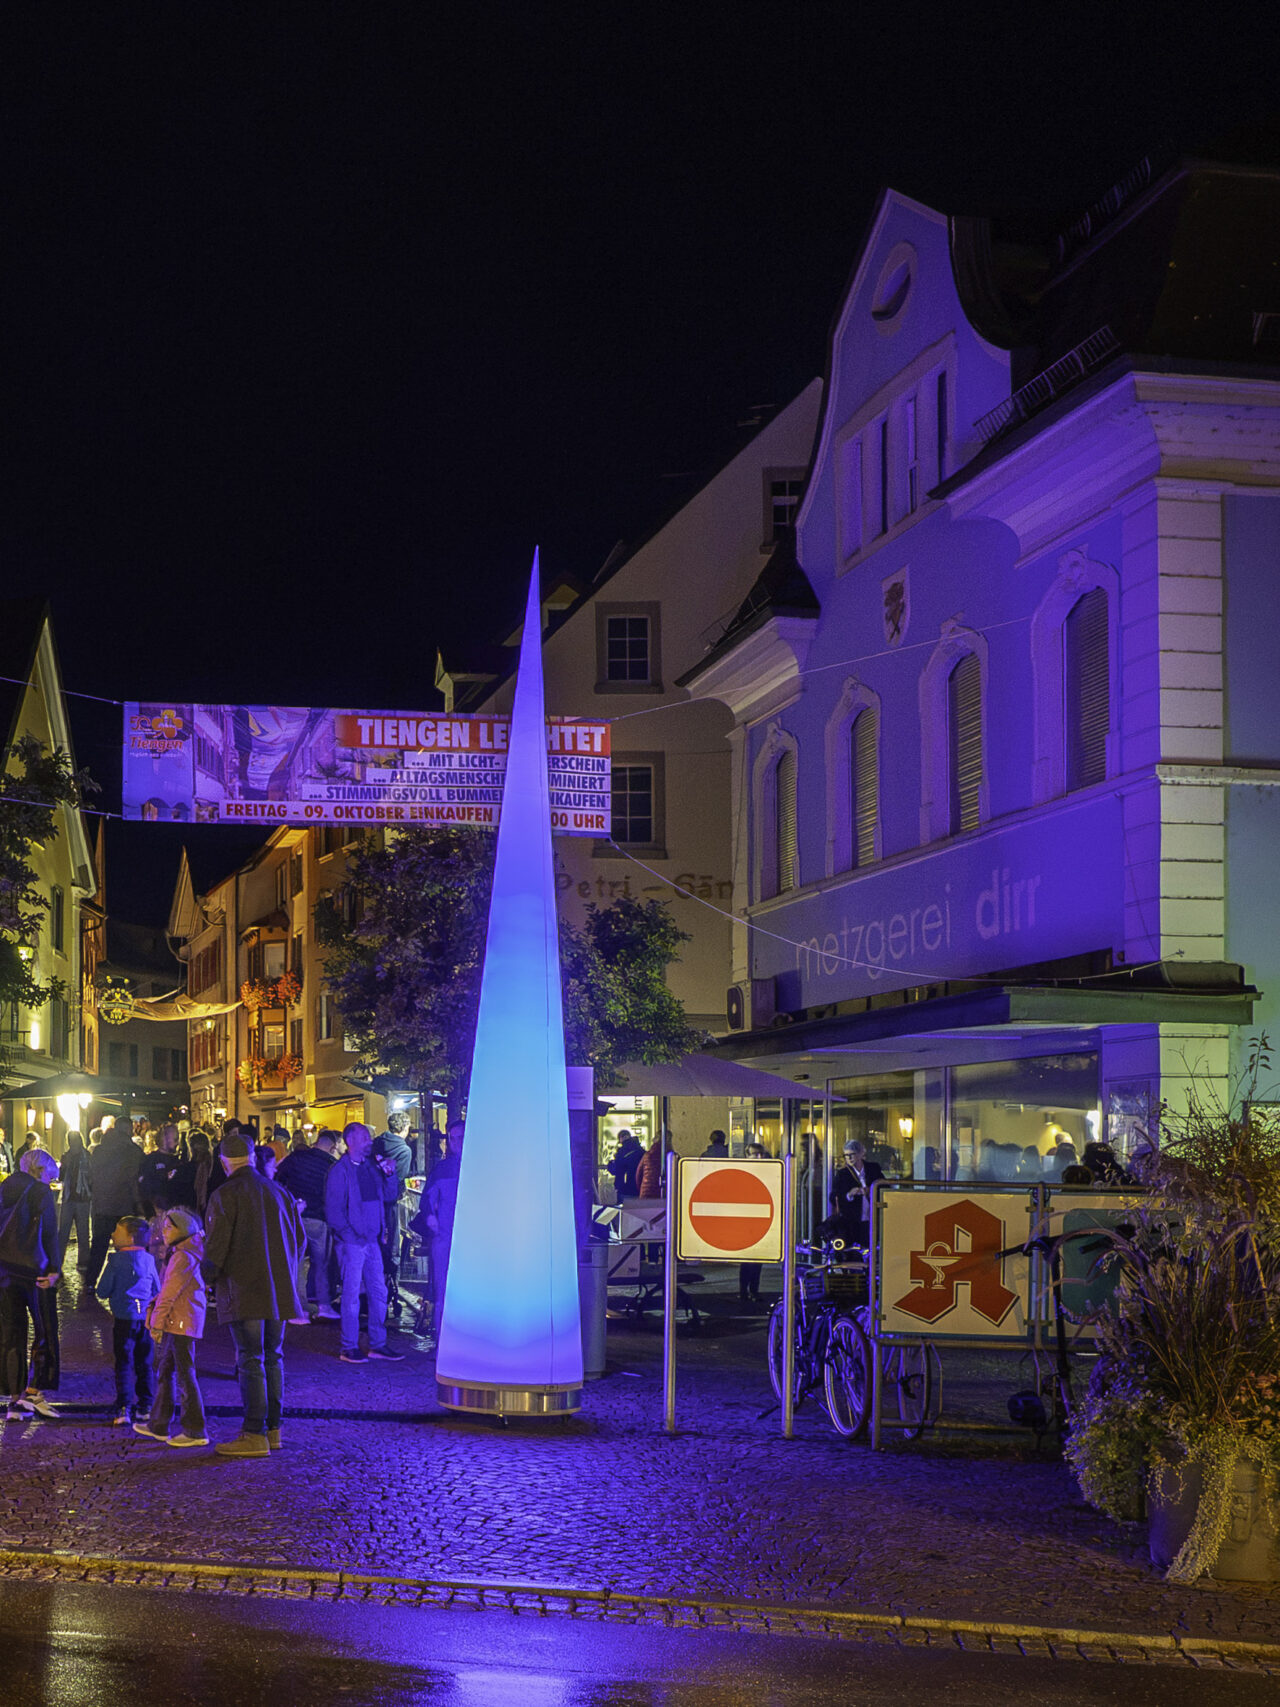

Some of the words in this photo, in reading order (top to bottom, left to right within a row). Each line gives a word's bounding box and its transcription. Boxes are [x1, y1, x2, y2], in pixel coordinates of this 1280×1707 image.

[130, 736, 183, 752] Tiengen
[357, 719, 469, 747] TIENGEN
[480, 722, 605, 752] LEHTET
[428, 754, 454, 767] MIT
[458, 755, 500, 768] LICHT-
[389, 770, 505, 785] ALLTAGSMENSCH
[549, 773, 606, 790] MINIERT
[326, 786, 443, 801] STIMMUNGSVOLL
[447, 788, 504, 801] BUMME
[226, 804, 287, 817] FREITAG
[304, 805, 328, 818] 09.
[333, 806, 404, 819] OKTOBER
[409, 807, 493, 821] EINKAUFEN
[573, 813, 605, 829] UHR
[795, 882, 951, 982] metzgerei
[976, 867, 1041, 941] dirr
